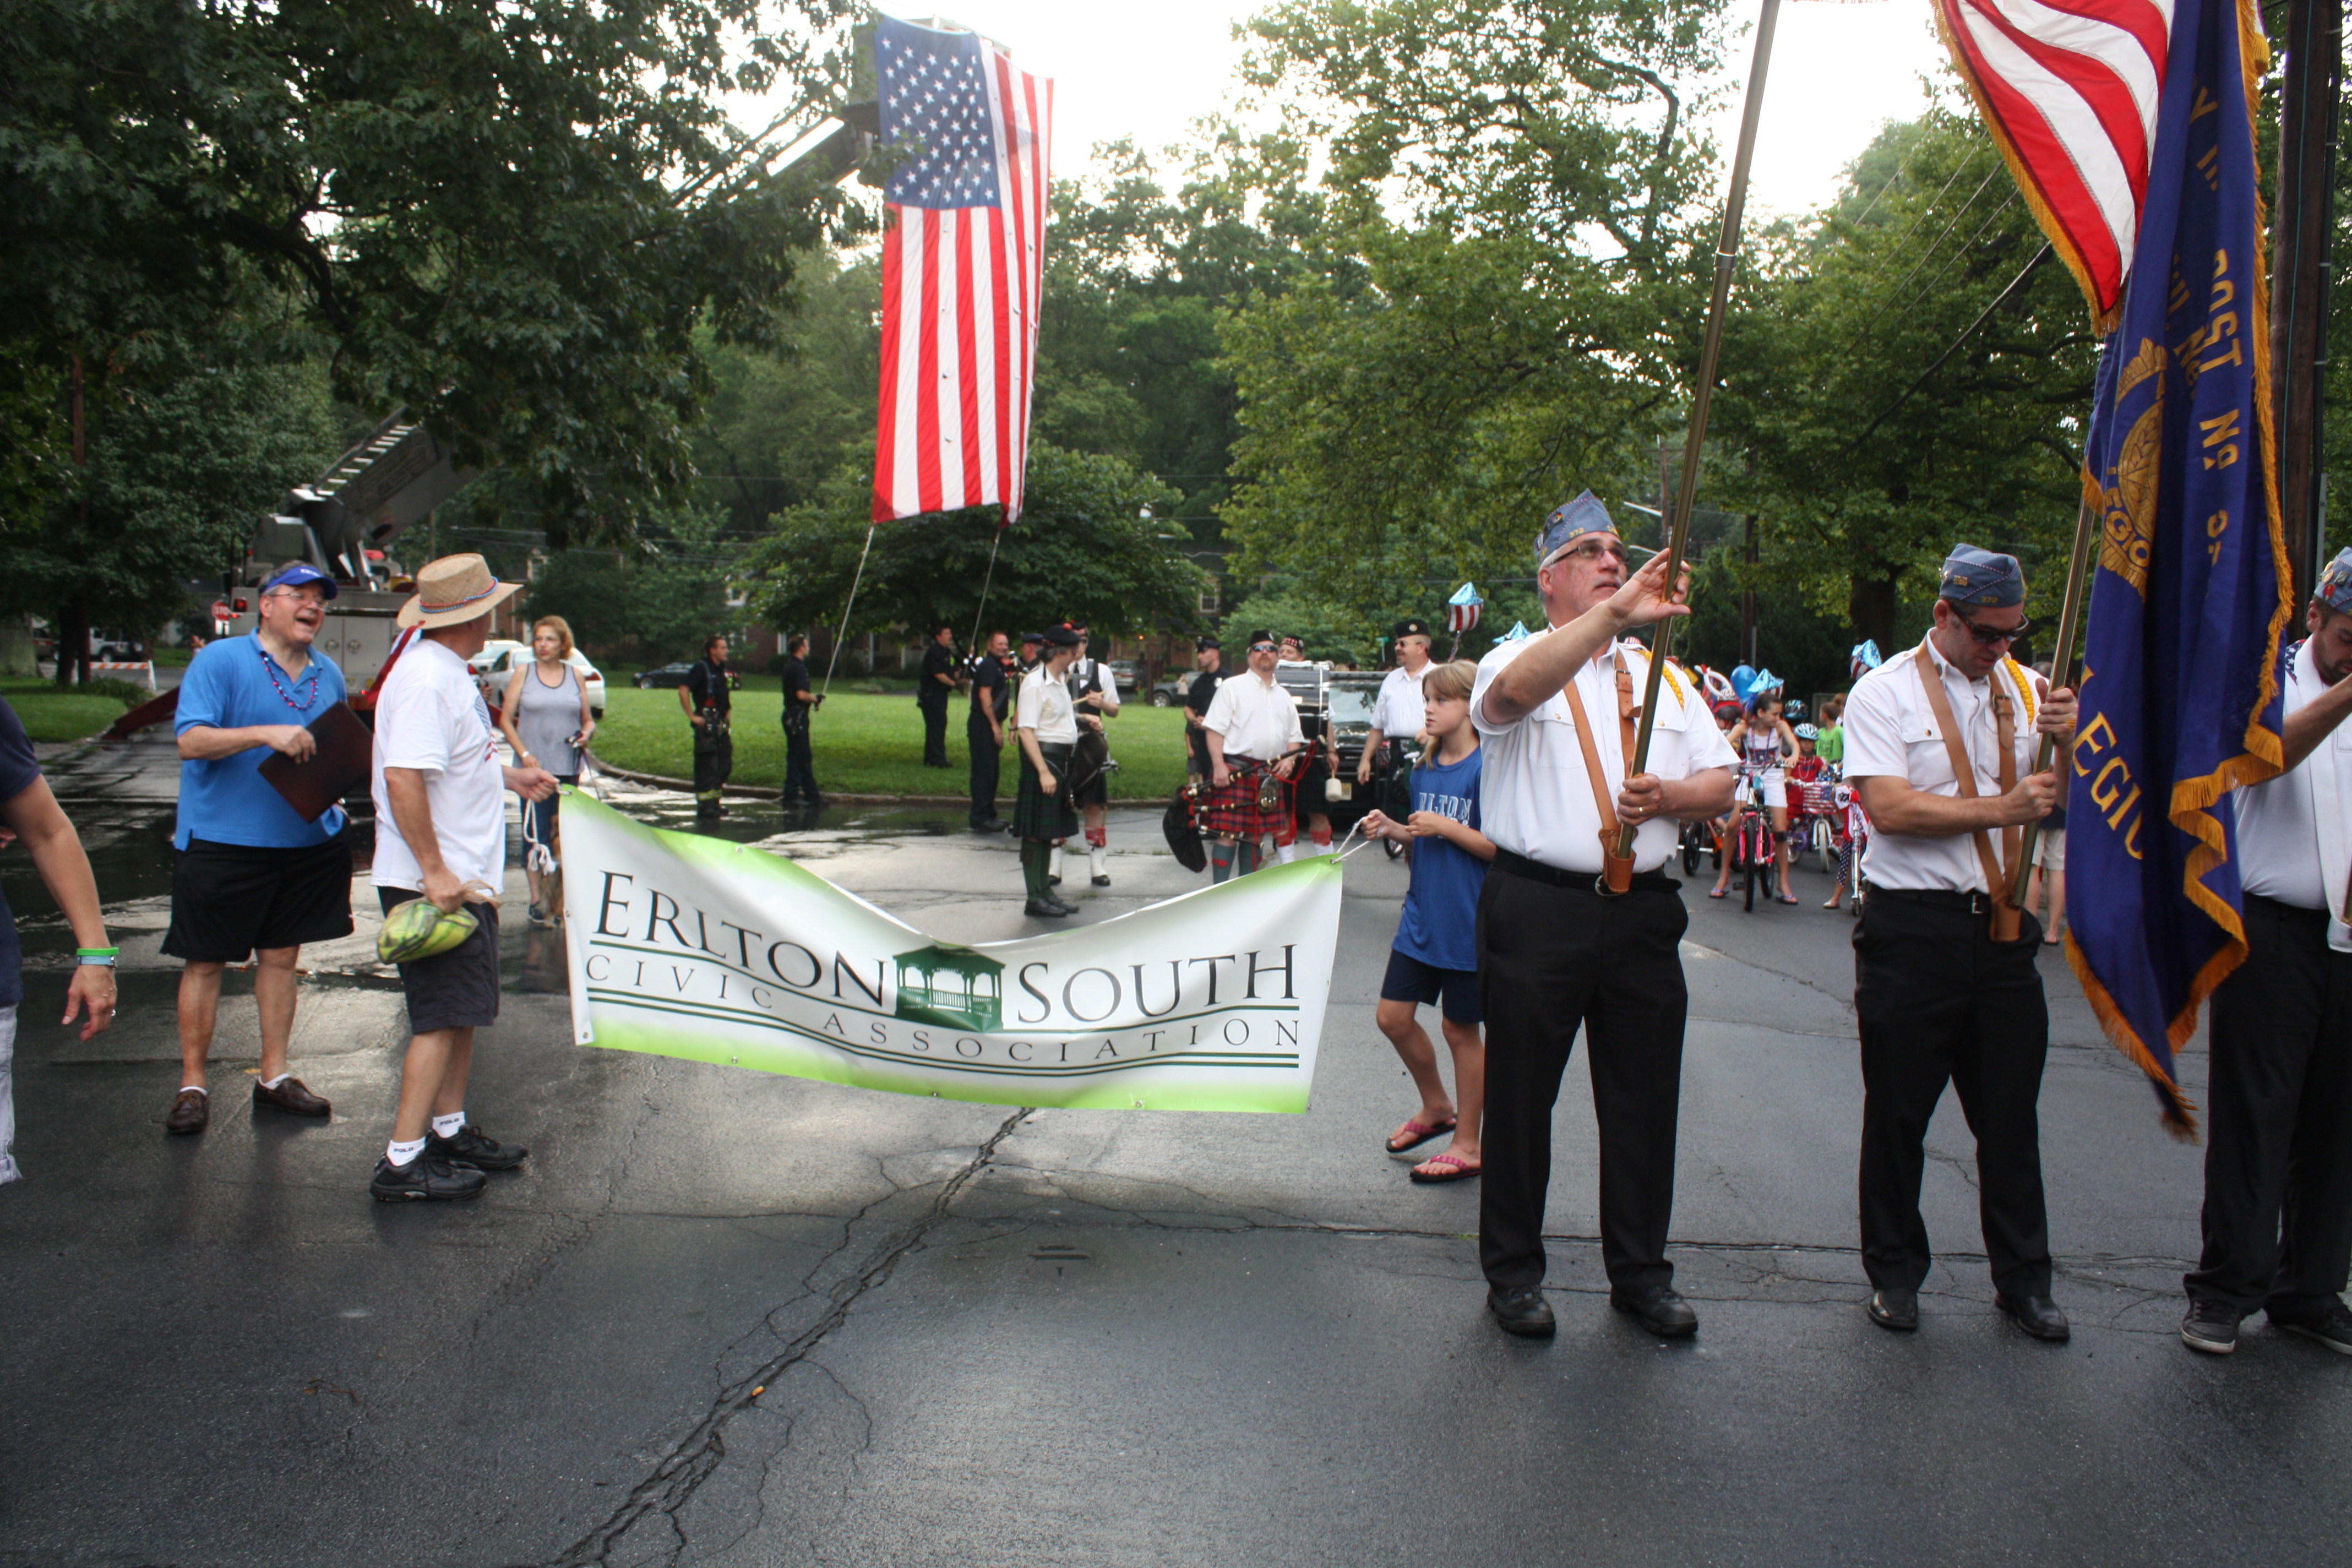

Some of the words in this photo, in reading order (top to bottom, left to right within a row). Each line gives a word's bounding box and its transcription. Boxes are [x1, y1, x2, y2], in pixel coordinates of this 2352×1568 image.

[2104, 467, 2152, 567] EGIO
[2072, 665, 2143, 860] EGI
[586, 954, 773, 1009] CIVIC
[823, 1013, 1300, 1062] ASSOCIATION
[593, 869, 887, 1007] ERLTON
[1017, 944, 1300, 1023] SOUTH
